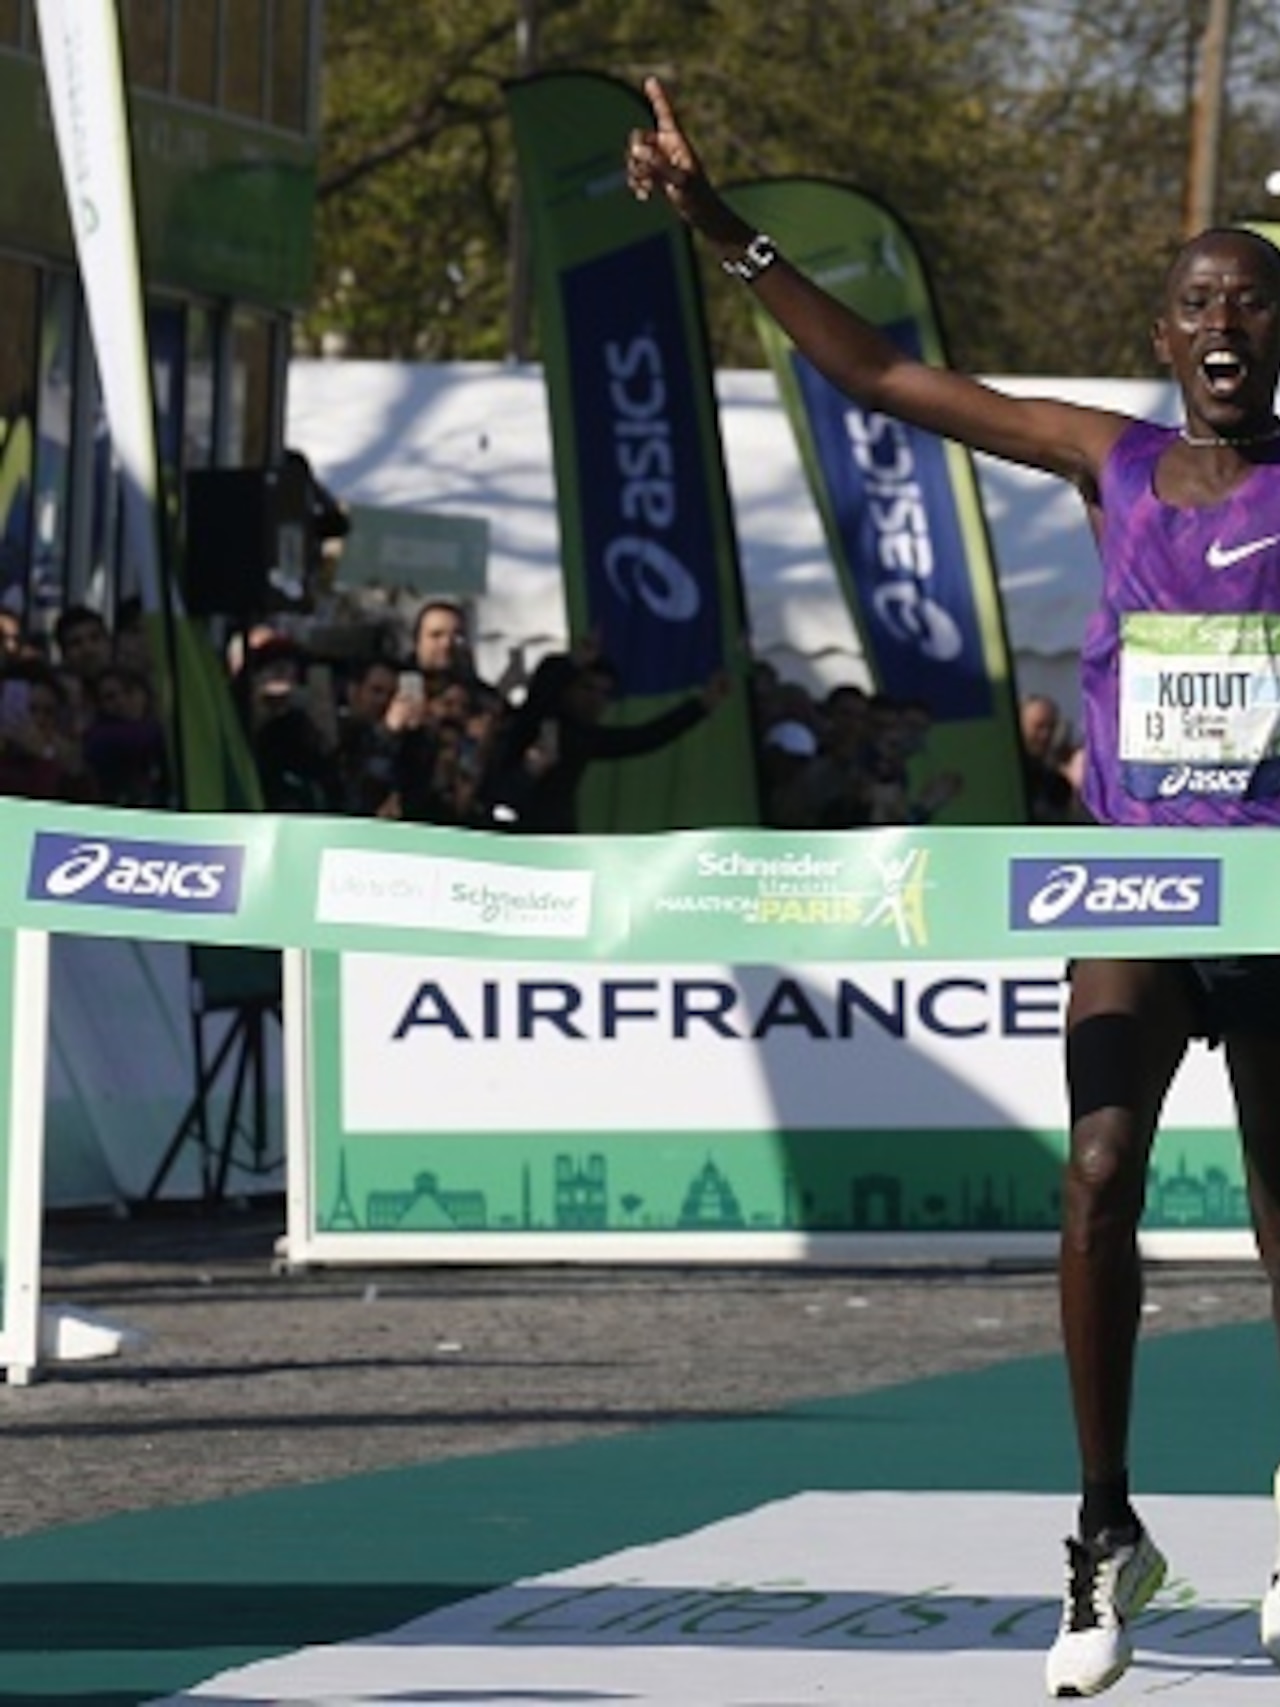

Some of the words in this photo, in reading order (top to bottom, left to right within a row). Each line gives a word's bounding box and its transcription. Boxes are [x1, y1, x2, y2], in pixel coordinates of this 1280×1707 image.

[1159, 672, 1251, 709] KOTUT
[1144, 711, 1165, 742] 13
[104, 856, 225, 898] asics
[697, 852, 843, 877] Schneider
[450, 882, 578, 917] Schneider
[761, 898, 863, 923] PARIS
[1084, 875, 1203, 911] asics
